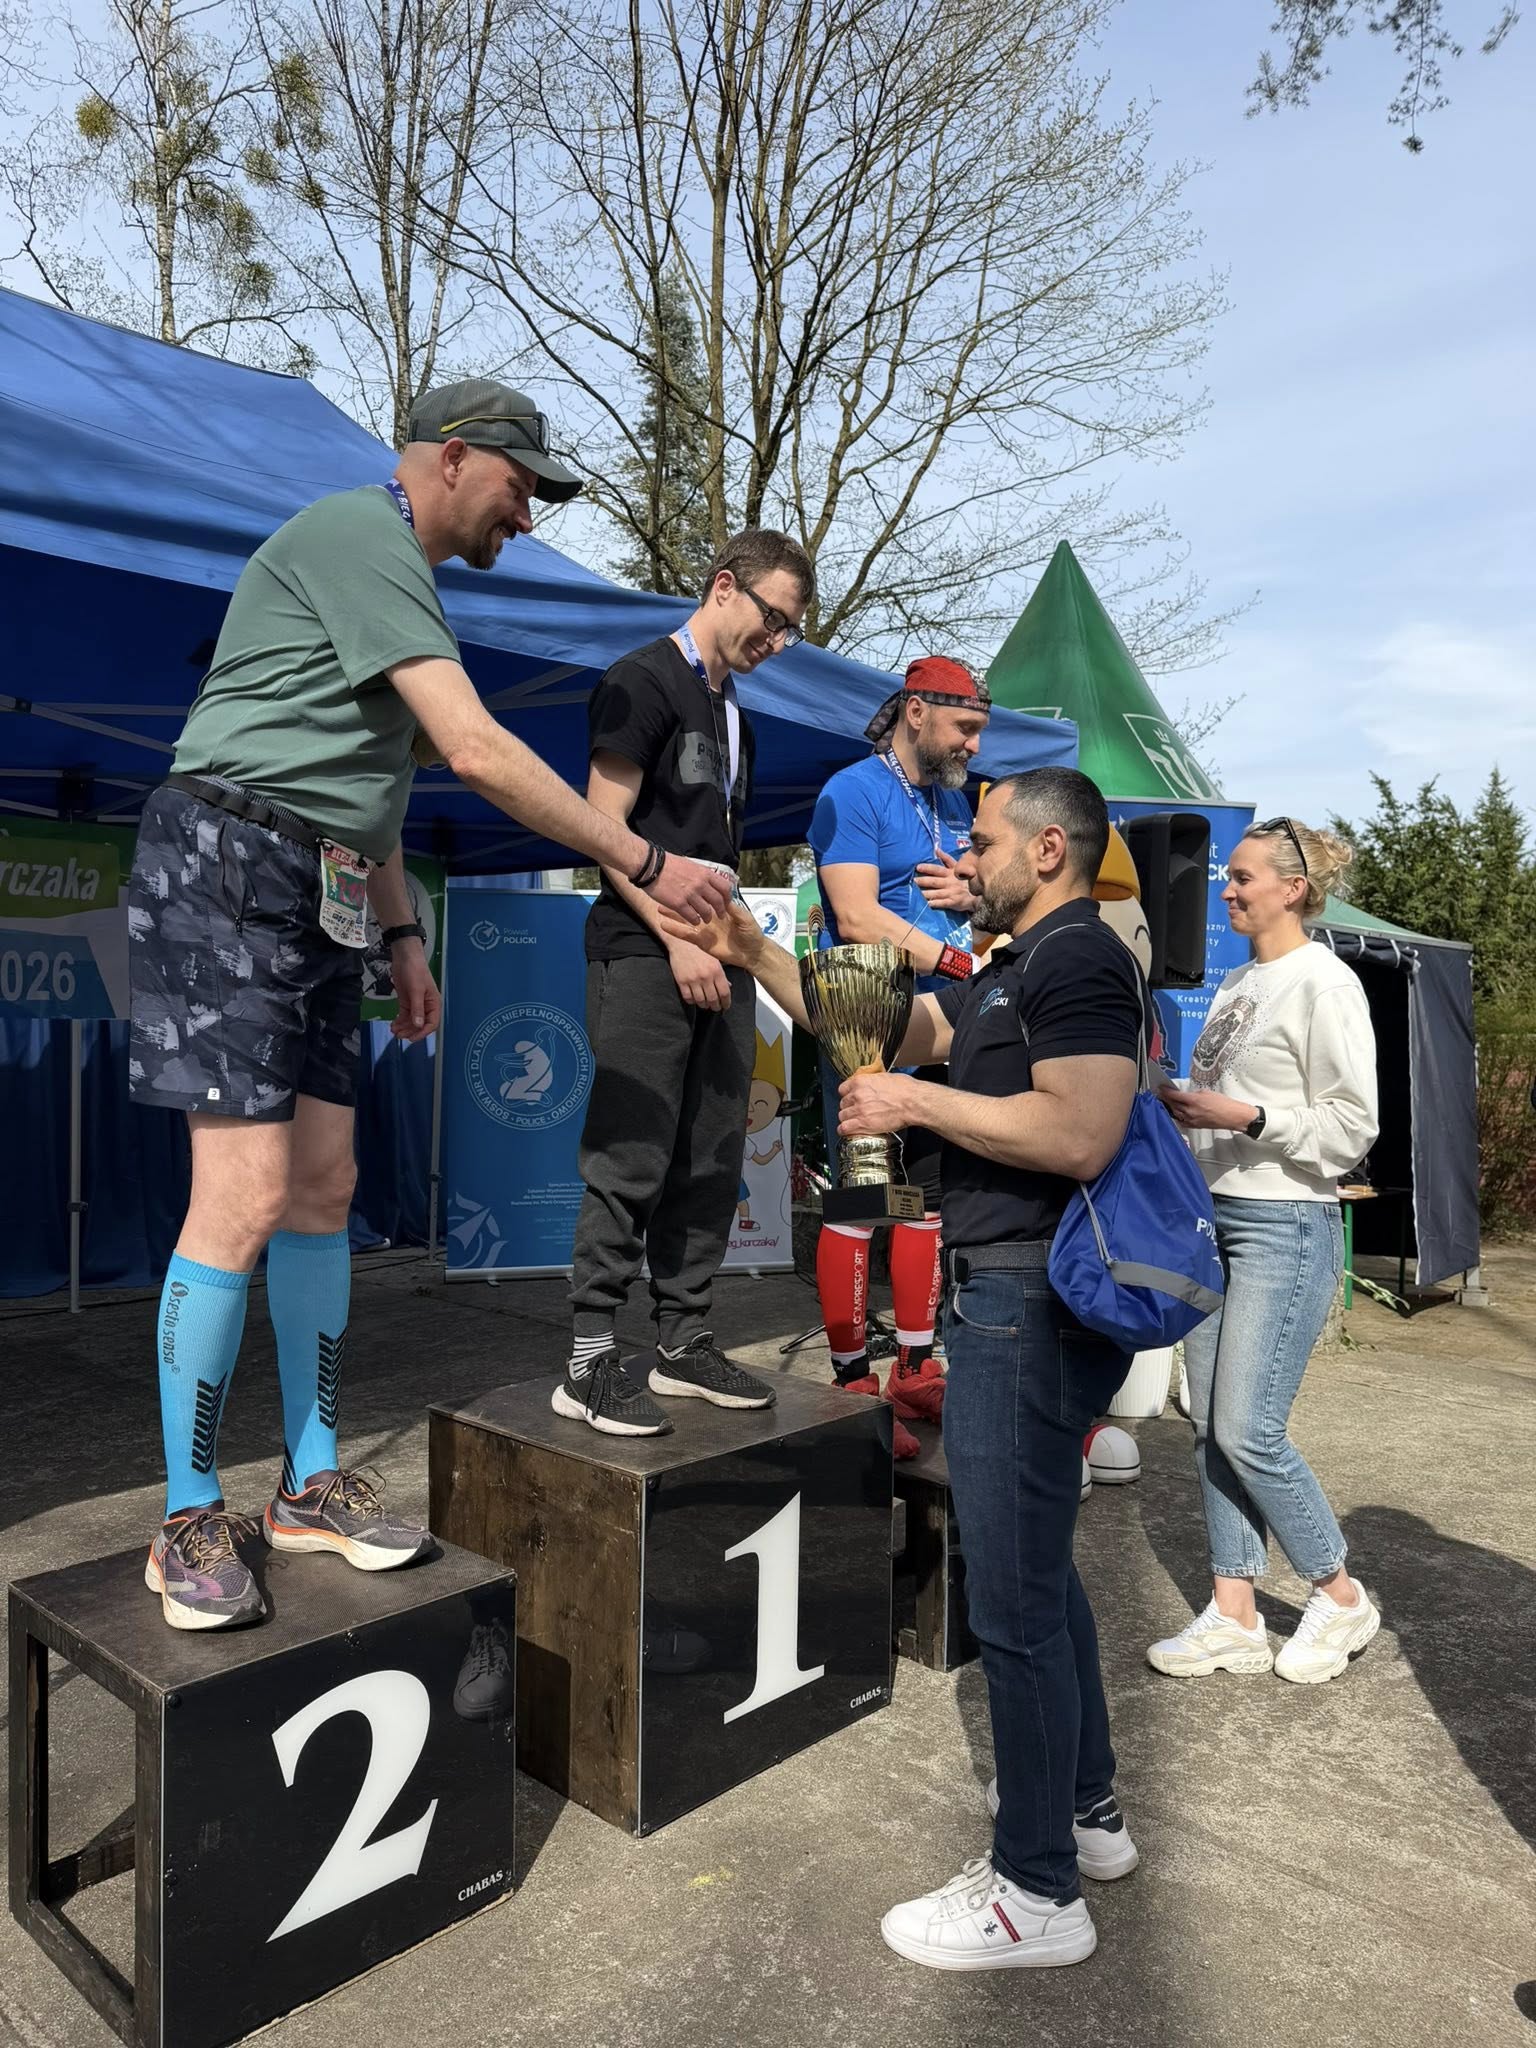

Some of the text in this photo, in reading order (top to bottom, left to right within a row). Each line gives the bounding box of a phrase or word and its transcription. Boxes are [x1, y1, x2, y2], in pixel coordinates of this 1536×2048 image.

[0, 857, 100, 900] rczaka
[503, 936, 537, 944] POLICKI
[0, 950, 76, 1001] 026
[1177, 1010, 1207, 1021] Integr
[476, 1017, 502, 1048] DZIECI
[470, 1048, 481, 1070] DLA
[473, 1080, 487, 1098] NR
[551, 1073, 588, 1120] RUCHOWO
[481, 1096, 510, 1120] SOSW
[515, 1115, 546, 1127] POLICE
[1196, 1216, 1218, 1246] POL
[164, 1295, 181, 1328] sesto
[723, 1490, 825, 1725] 1
[850, 1685, 882, 1709] CHABAS
[265, 1669, 439, 1943] 2
[457, 1869, 504, 1902] CHABAS
